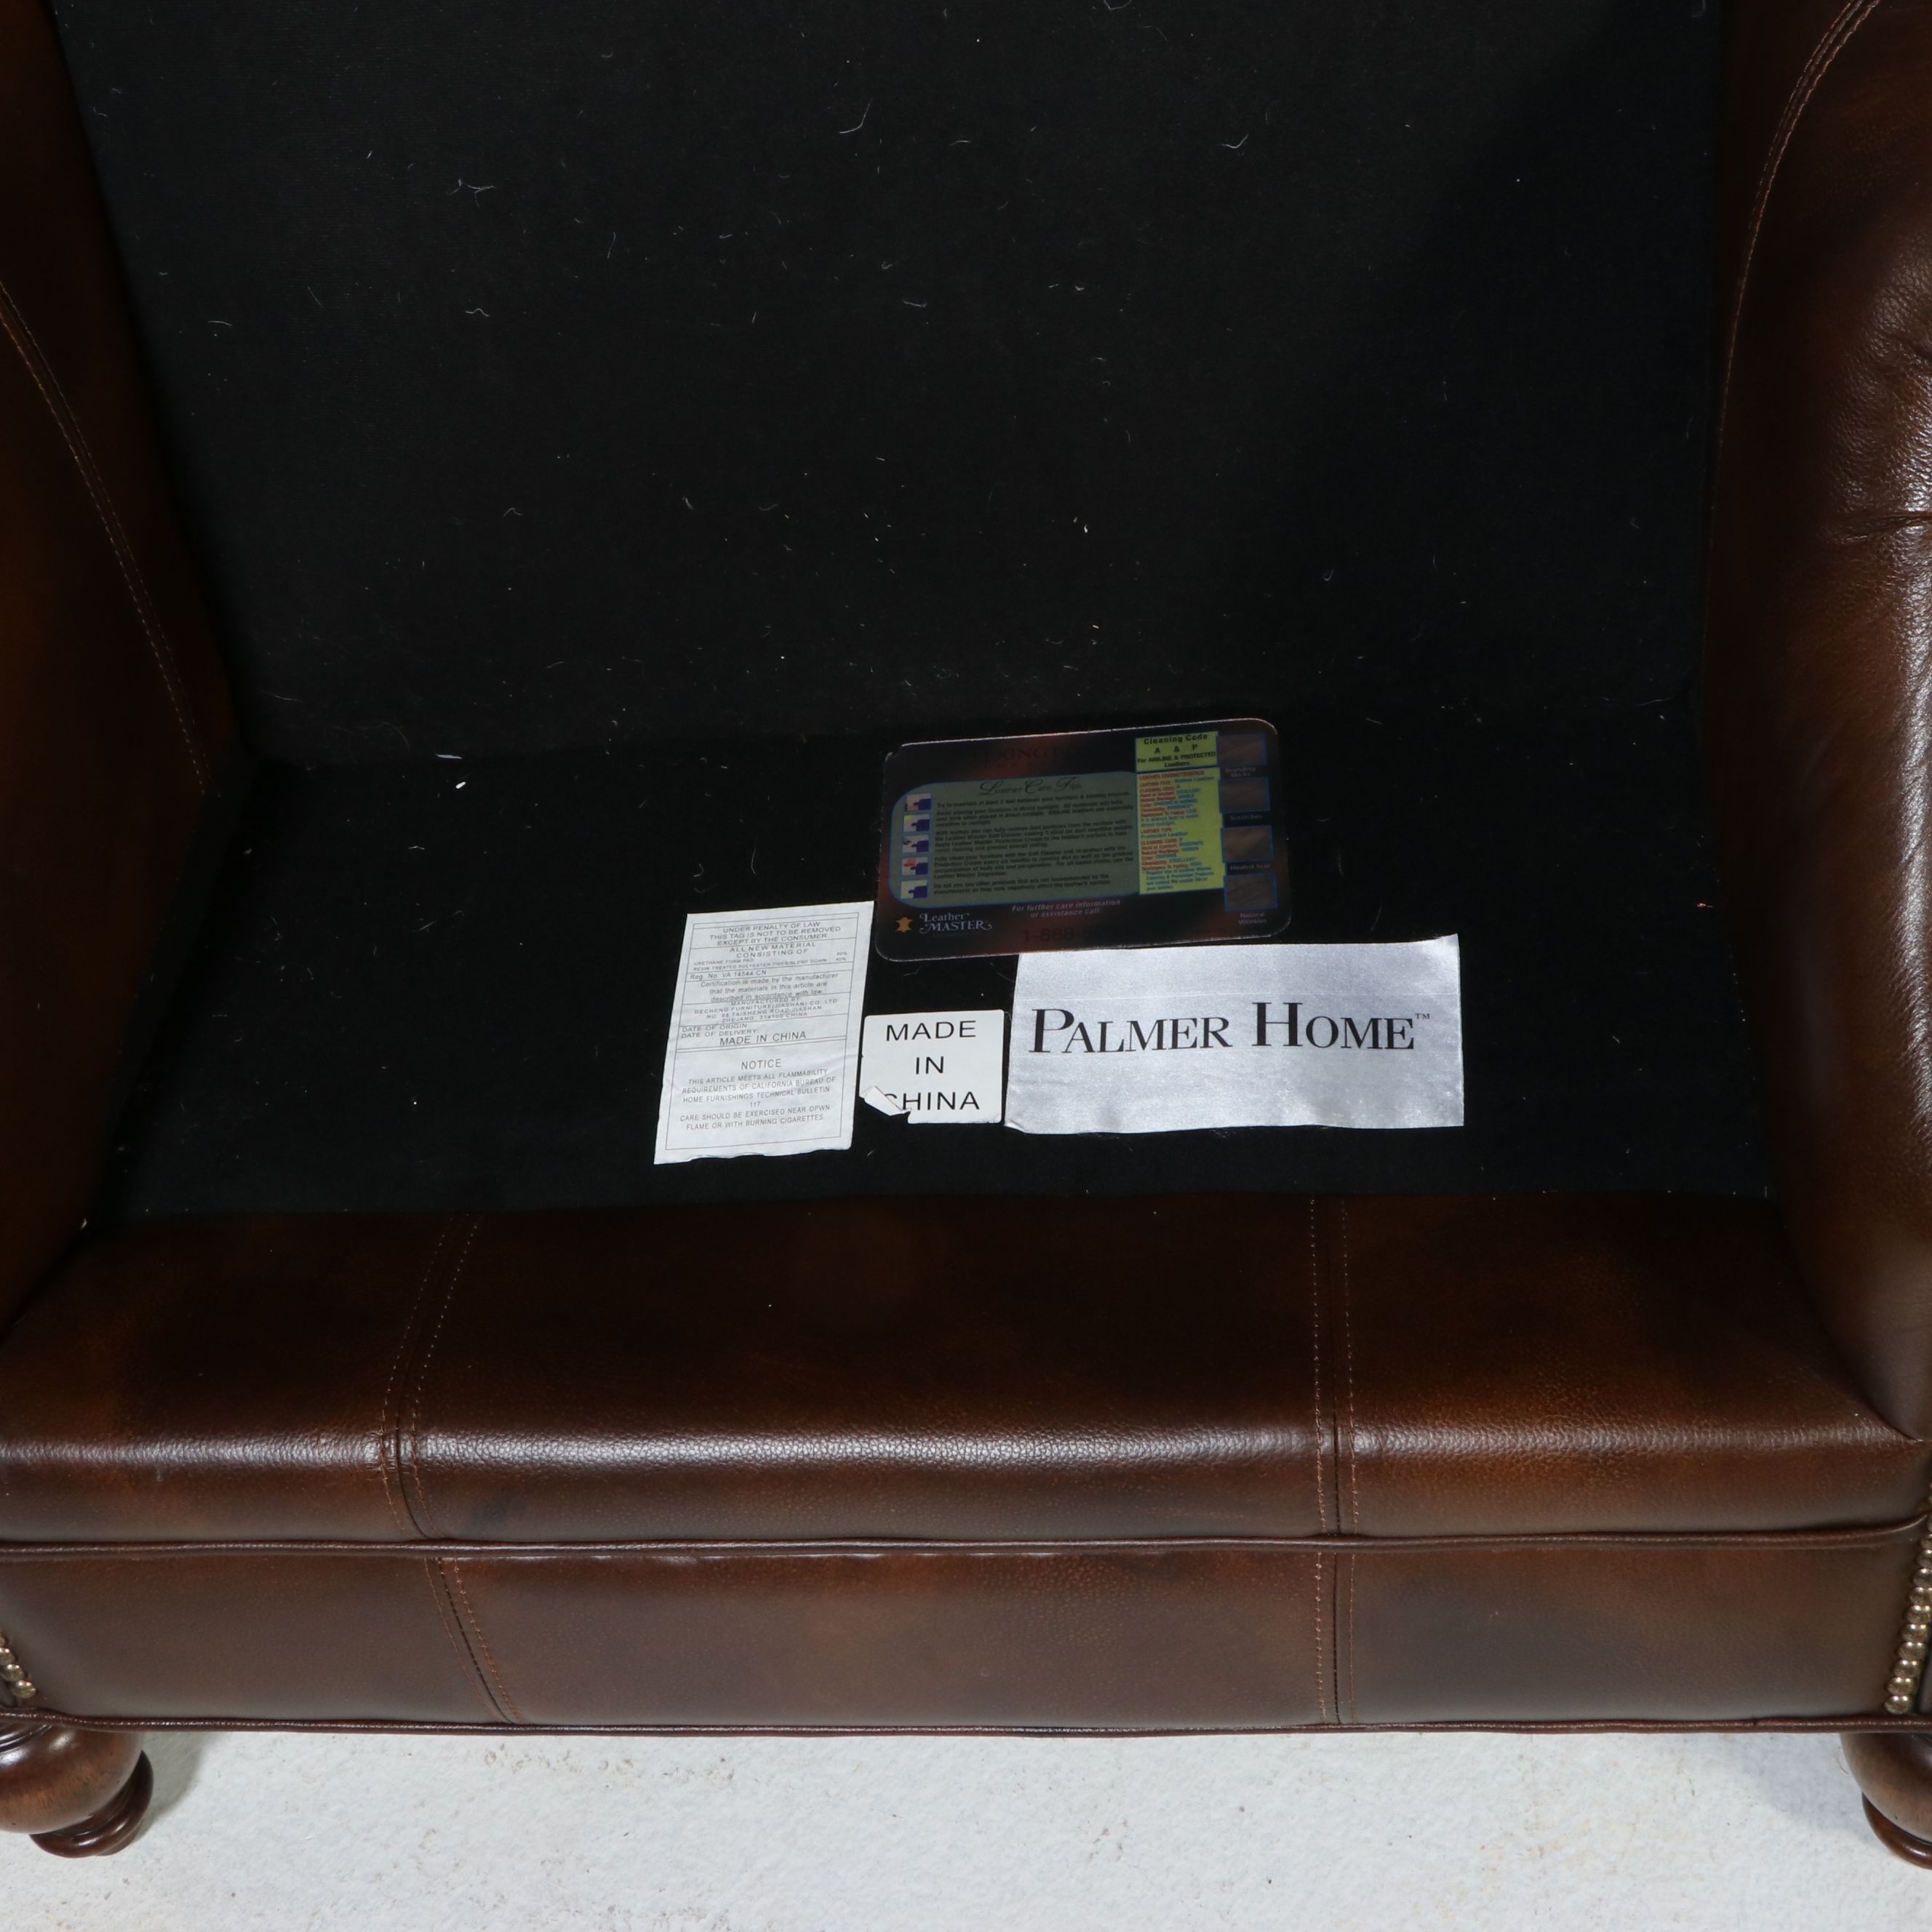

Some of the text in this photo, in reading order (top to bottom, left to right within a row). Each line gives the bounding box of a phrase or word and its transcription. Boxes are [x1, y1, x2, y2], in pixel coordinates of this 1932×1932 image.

[1144, 735, 1183, 744] Cleaning
[1075, 899, 1121, 908] information
[919, 913, 970, 923] Leather
[1041, 909, 1087, 917] assistance
[801, 926, 840, 934] REMOVED
[919, 919, 992, 934] MASTER
[784, 933, 827, 941] CONSUMER
[771, 941, 815, 950] MATERIAL
[735, 949, 794, 958] CONSISTING
[700, 979, 740, 988] Certification
[795, 972, 838, 981] manufacturer
[754, 991, 792, 999] accordance
[886, 1021, 976, 1042] MADE
[1028, 1008, 1234, 1053] PALMER
[719, 1031, 806, 1045] MADE IN CHINA
[741, 1058, 782, 1070] NOTICE
[915, 1056, 944, 1074] IN
[778, 1069, 827, 1078] FLAMMABILITY
[682, 1084, 737, 1094] REQUIREMENTS
[751, 1080, 793, 1089] CALIFORNIA
[795, 1077, 823, 1085] BUREAU
[706, 1093, 754, 1102] FURNISHINGS
[756, 1089, 795, 1098] TECHNICAL
[797, 1086, 830, 1095] BULLETIN
[701, 1112, 730, 1120] SHOULD
[745, 1108, 785, 1117] EXERCISED
[787, 1106, 806, 1114] NEAR
[686, 1122, 708, 1130] FLAME
[745, 1118, 777, 1126] BURNING
[780, 1114, 823, 1124] CIGARETTES
